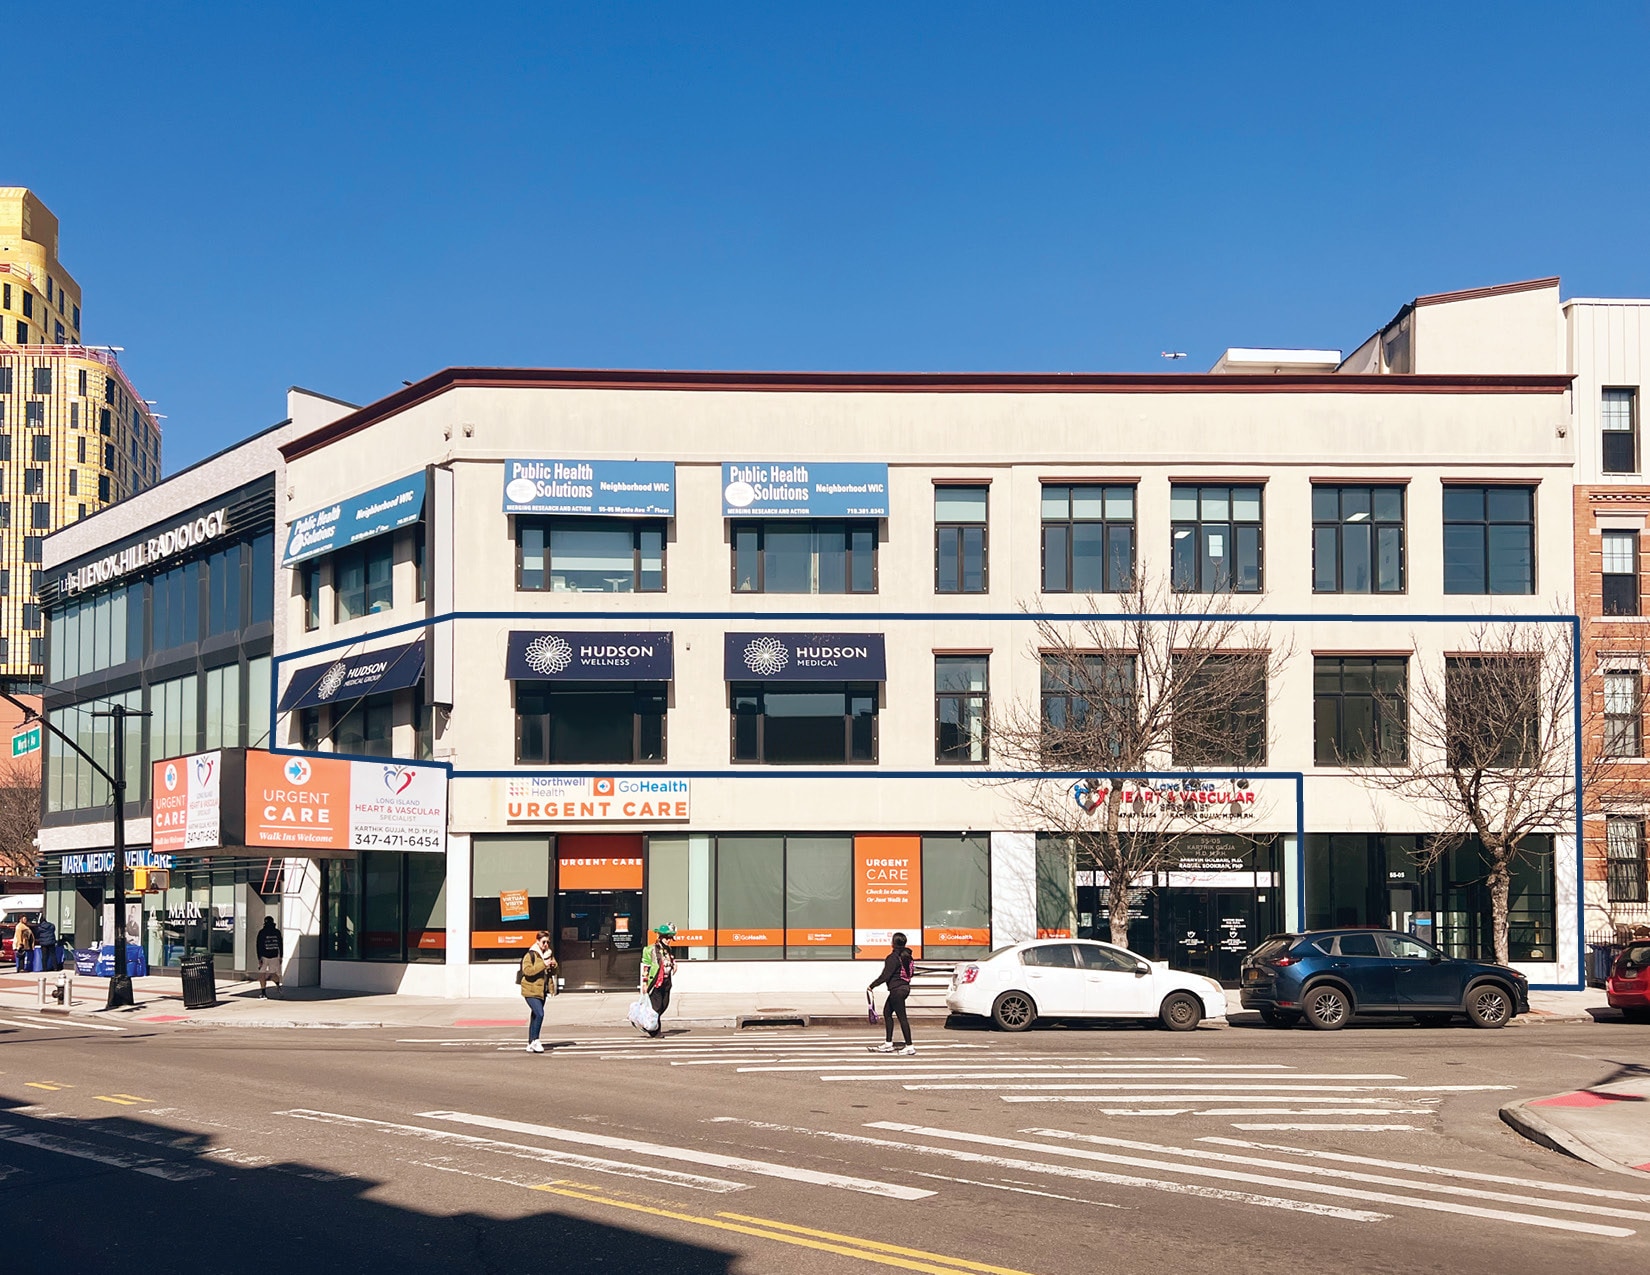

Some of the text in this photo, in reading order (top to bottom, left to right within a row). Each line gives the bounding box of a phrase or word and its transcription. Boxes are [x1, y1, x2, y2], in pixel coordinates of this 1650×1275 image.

[513, 462, 593, 480] Public Health
[730, 466, 808, 483] Public Health
[536, 480, 593, 498] Solutions
[600, 482, 670, 493] Neighborhood WIC
[754, 484, 809, 501] Solutions
[816, 484, 884, 495] Neighborhood WIC
[294, 505, 341, 535] Public Health
[302, 526, 336, 547] Solutions
[82, 554, 119, 589] LENOX
[119, 543, 146, 574] HILL
[148, 508, 228, 563] RADIOLOGY
[580, 646, 653, 657] HUDSON
[796, 647, 867, 658] HUDSON
[581, 658, 630, 666] WELLNESS
[797, 659, 838, 667] MEDICAL
[347, 661, 388, 679] HUDSON
[532, 777, 688, 793] Northwell GoHealth
[532, 787, 565, 797] Health
[156, 795, 186, 810] URGENT
[263, 789, 330, 805] URGENT
[395, 798, 420, 806] ISLAND
[1180, 791, 1255, 804] VASCULAR
[263, 806, 330, 823] CARE
[355, 804, 385, 813] HEART
[395, 806, 440, 816] VASCULAR
[508, 802, 687, 817] URGENT CARE
[156, 810, 186, 827] CARE
[379, 814, 417, 822] SPECIALIST
[259, 831, 333, 843] Walk Ins Welcome
[354, 833, 440, 847] 347-471-6454
[62, 855, 84, 875] MARK
[87, 852, 116, 873] MEDIC
[124, 850, 145, 867] VEIN
[561, 858, 642, 866] URGENT CARE
[866, 859, 909, 867] URGENT
[866, 869, 909, 880] CARE
[168, 901, 202, 919] MARK
